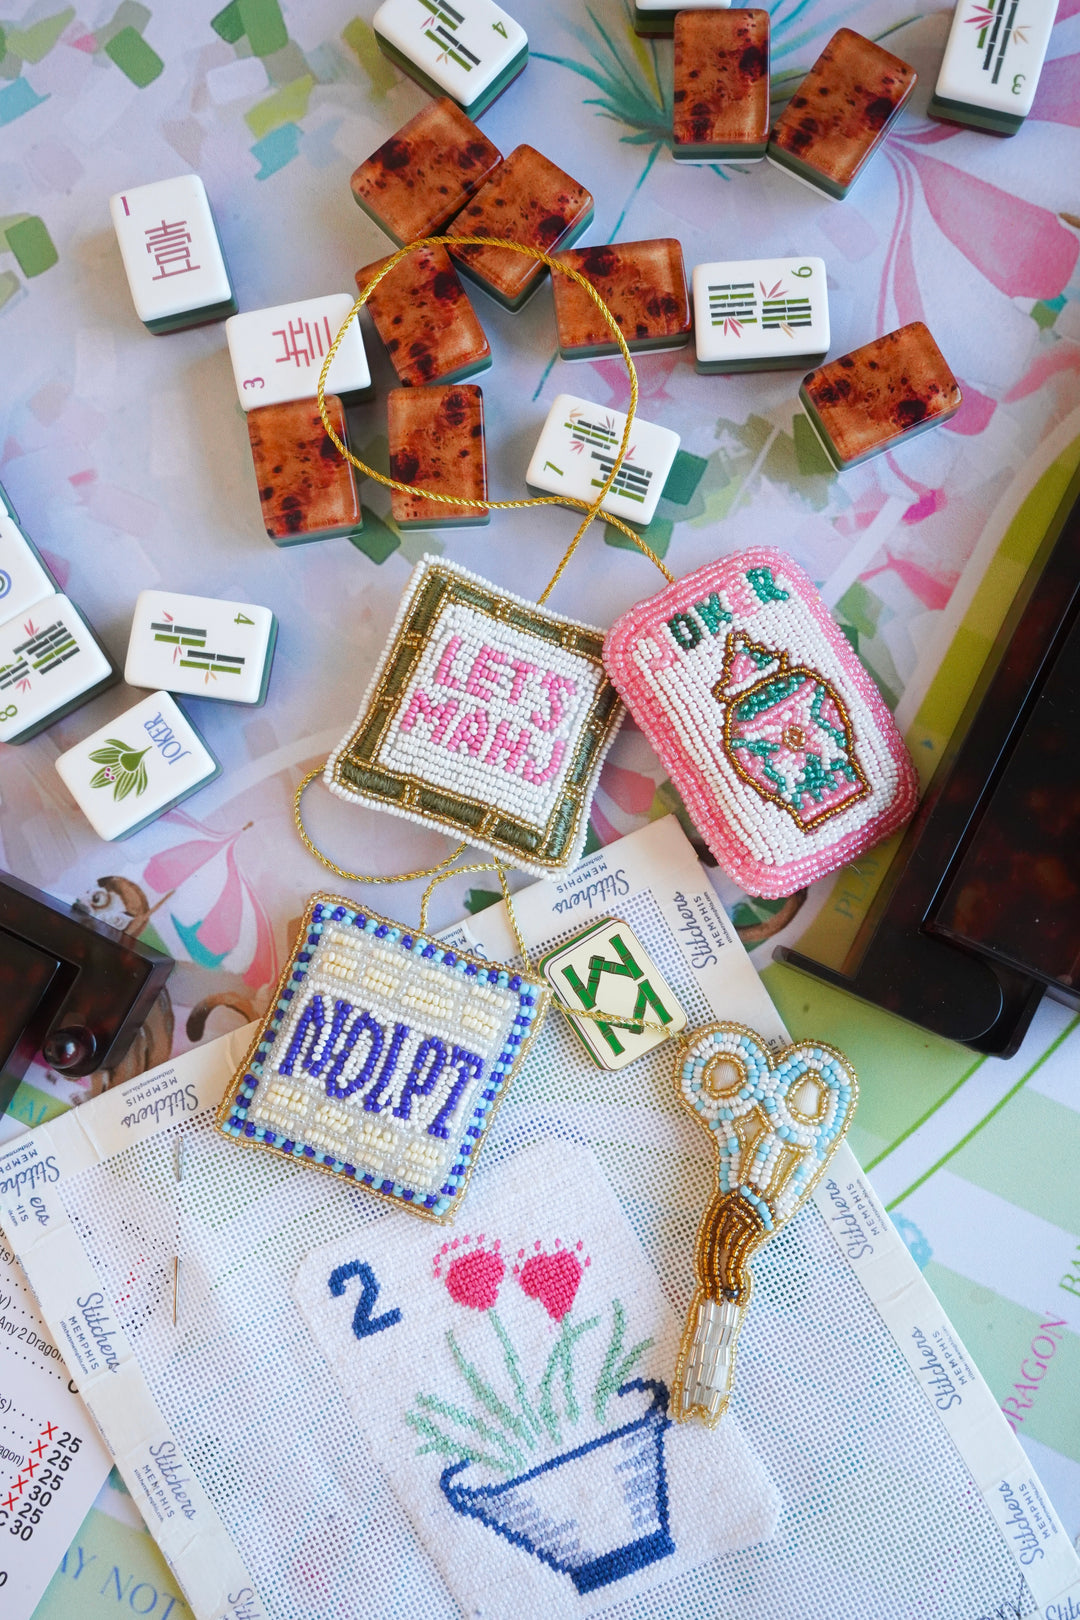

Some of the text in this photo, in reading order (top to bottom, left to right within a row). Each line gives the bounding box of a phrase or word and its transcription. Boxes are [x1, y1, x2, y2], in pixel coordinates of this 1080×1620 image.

[492, 21, 508, 39] 4
[1011, 74, 1026, 95] 3
[120, 196, 130, 216] 1
[243, 377, 265, 390] 3
[543, 461, 564, 476] 7
[234, 612, 255, 625] 4
[144, 712, 192, 765] JOKER
[400, 688, 566, 786] MAHJ
[552, 869, 630, 914] Stitchers
[556, 862, 608, 894] MEMPHIS
[673, 891, 718, 969] Stitchers
[693, 895, 725, 948] MEMPHIS
[121, 1084, 198, 1128] Stitchers
[126, 1076, 178, 1107] MEMPHIS
[826, 1179, 874, 1259] Stitchers
[847, 1183, 880, 1236] MEMPHIS
[328, 1259, 403, 1340] 2
[0, 1315, 19, 1337] Any
[17, 1327, 28, 1340] 2
[68, 1316, 99, 1370] MEMPHIS
[77, 1292, 120, 1374] Stitchers
[912, 1327, 962, 1410] Stitchers
[933, 1330, 968, 1385] MEMPHIS
[30, 1439, 72, 1472] X 25
[40, 1421, 82, 1453] X 25
[11, 1475, 52, 1507] X 30
[22, 1458, 40, 1478] X
[38, 1469, 64, 1491] 25
[142, 1464, 175, 1518] MEMPHIS
[149, 1441, 196, 1520] Stitchers
[1, 1492, 44, 1525] X 25
[9, 1519, 33, 1542] 30
[999, 1480, 1044, 1565] Stitchers
[1019, 1483, 1051, 1540] MEMPHIS
